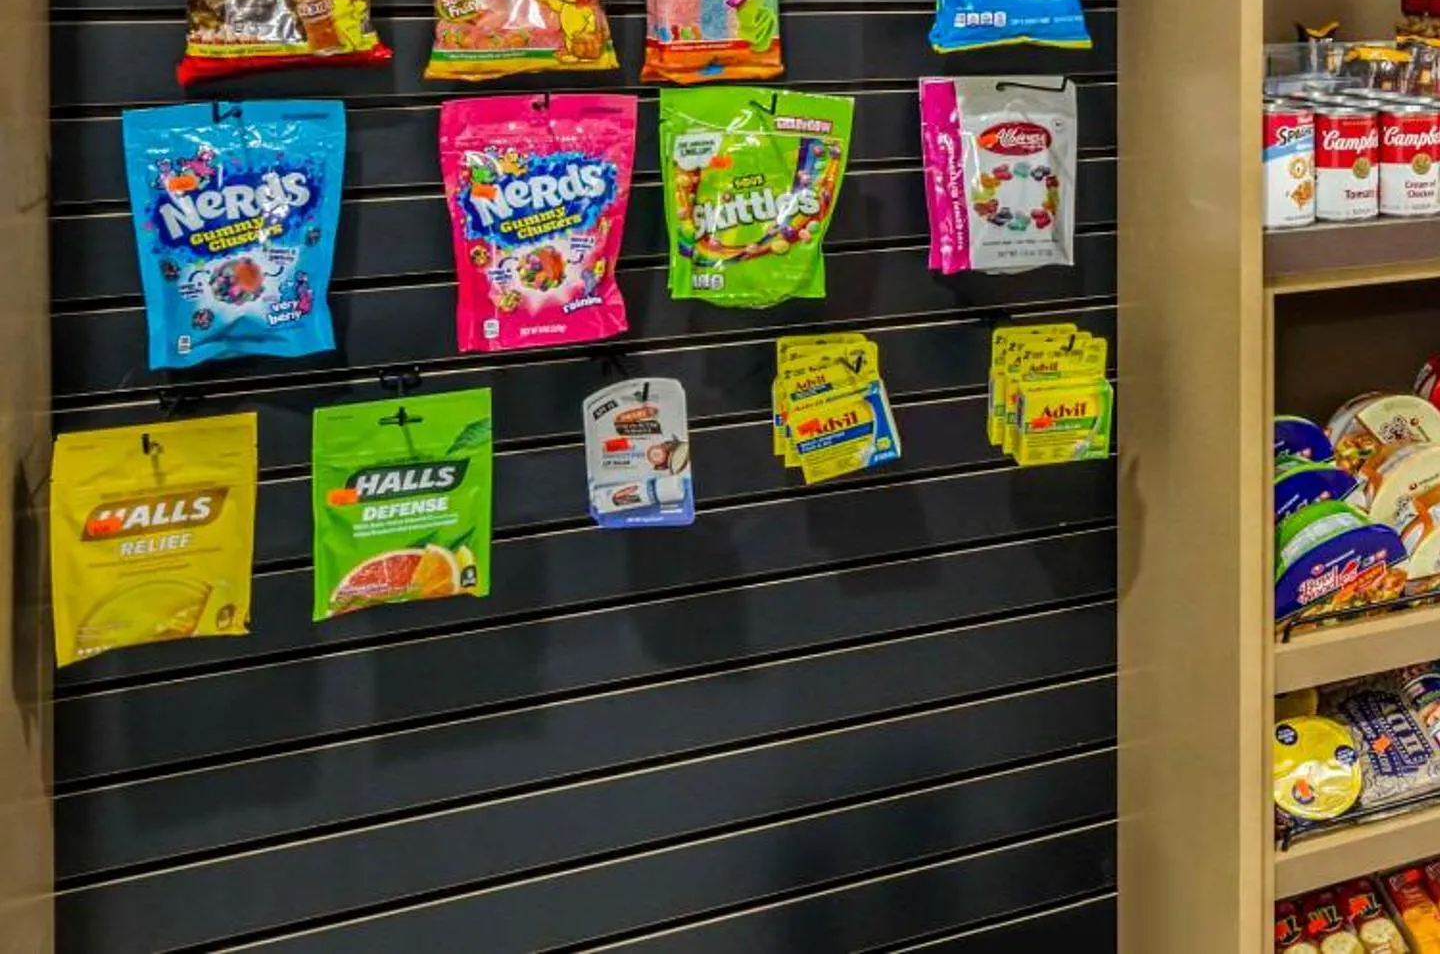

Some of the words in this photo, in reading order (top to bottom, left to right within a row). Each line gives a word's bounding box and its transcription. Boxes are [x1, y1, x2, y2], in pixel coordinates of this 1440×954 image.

[1041, 402, 1088, 418] Advil
[355, 466, 458, 497] HALLS
[96, 496, 212, 531] ALLS
[362, 496, 449, 522] DEFENSE
[120, 533, 193, 557] RELIEF
